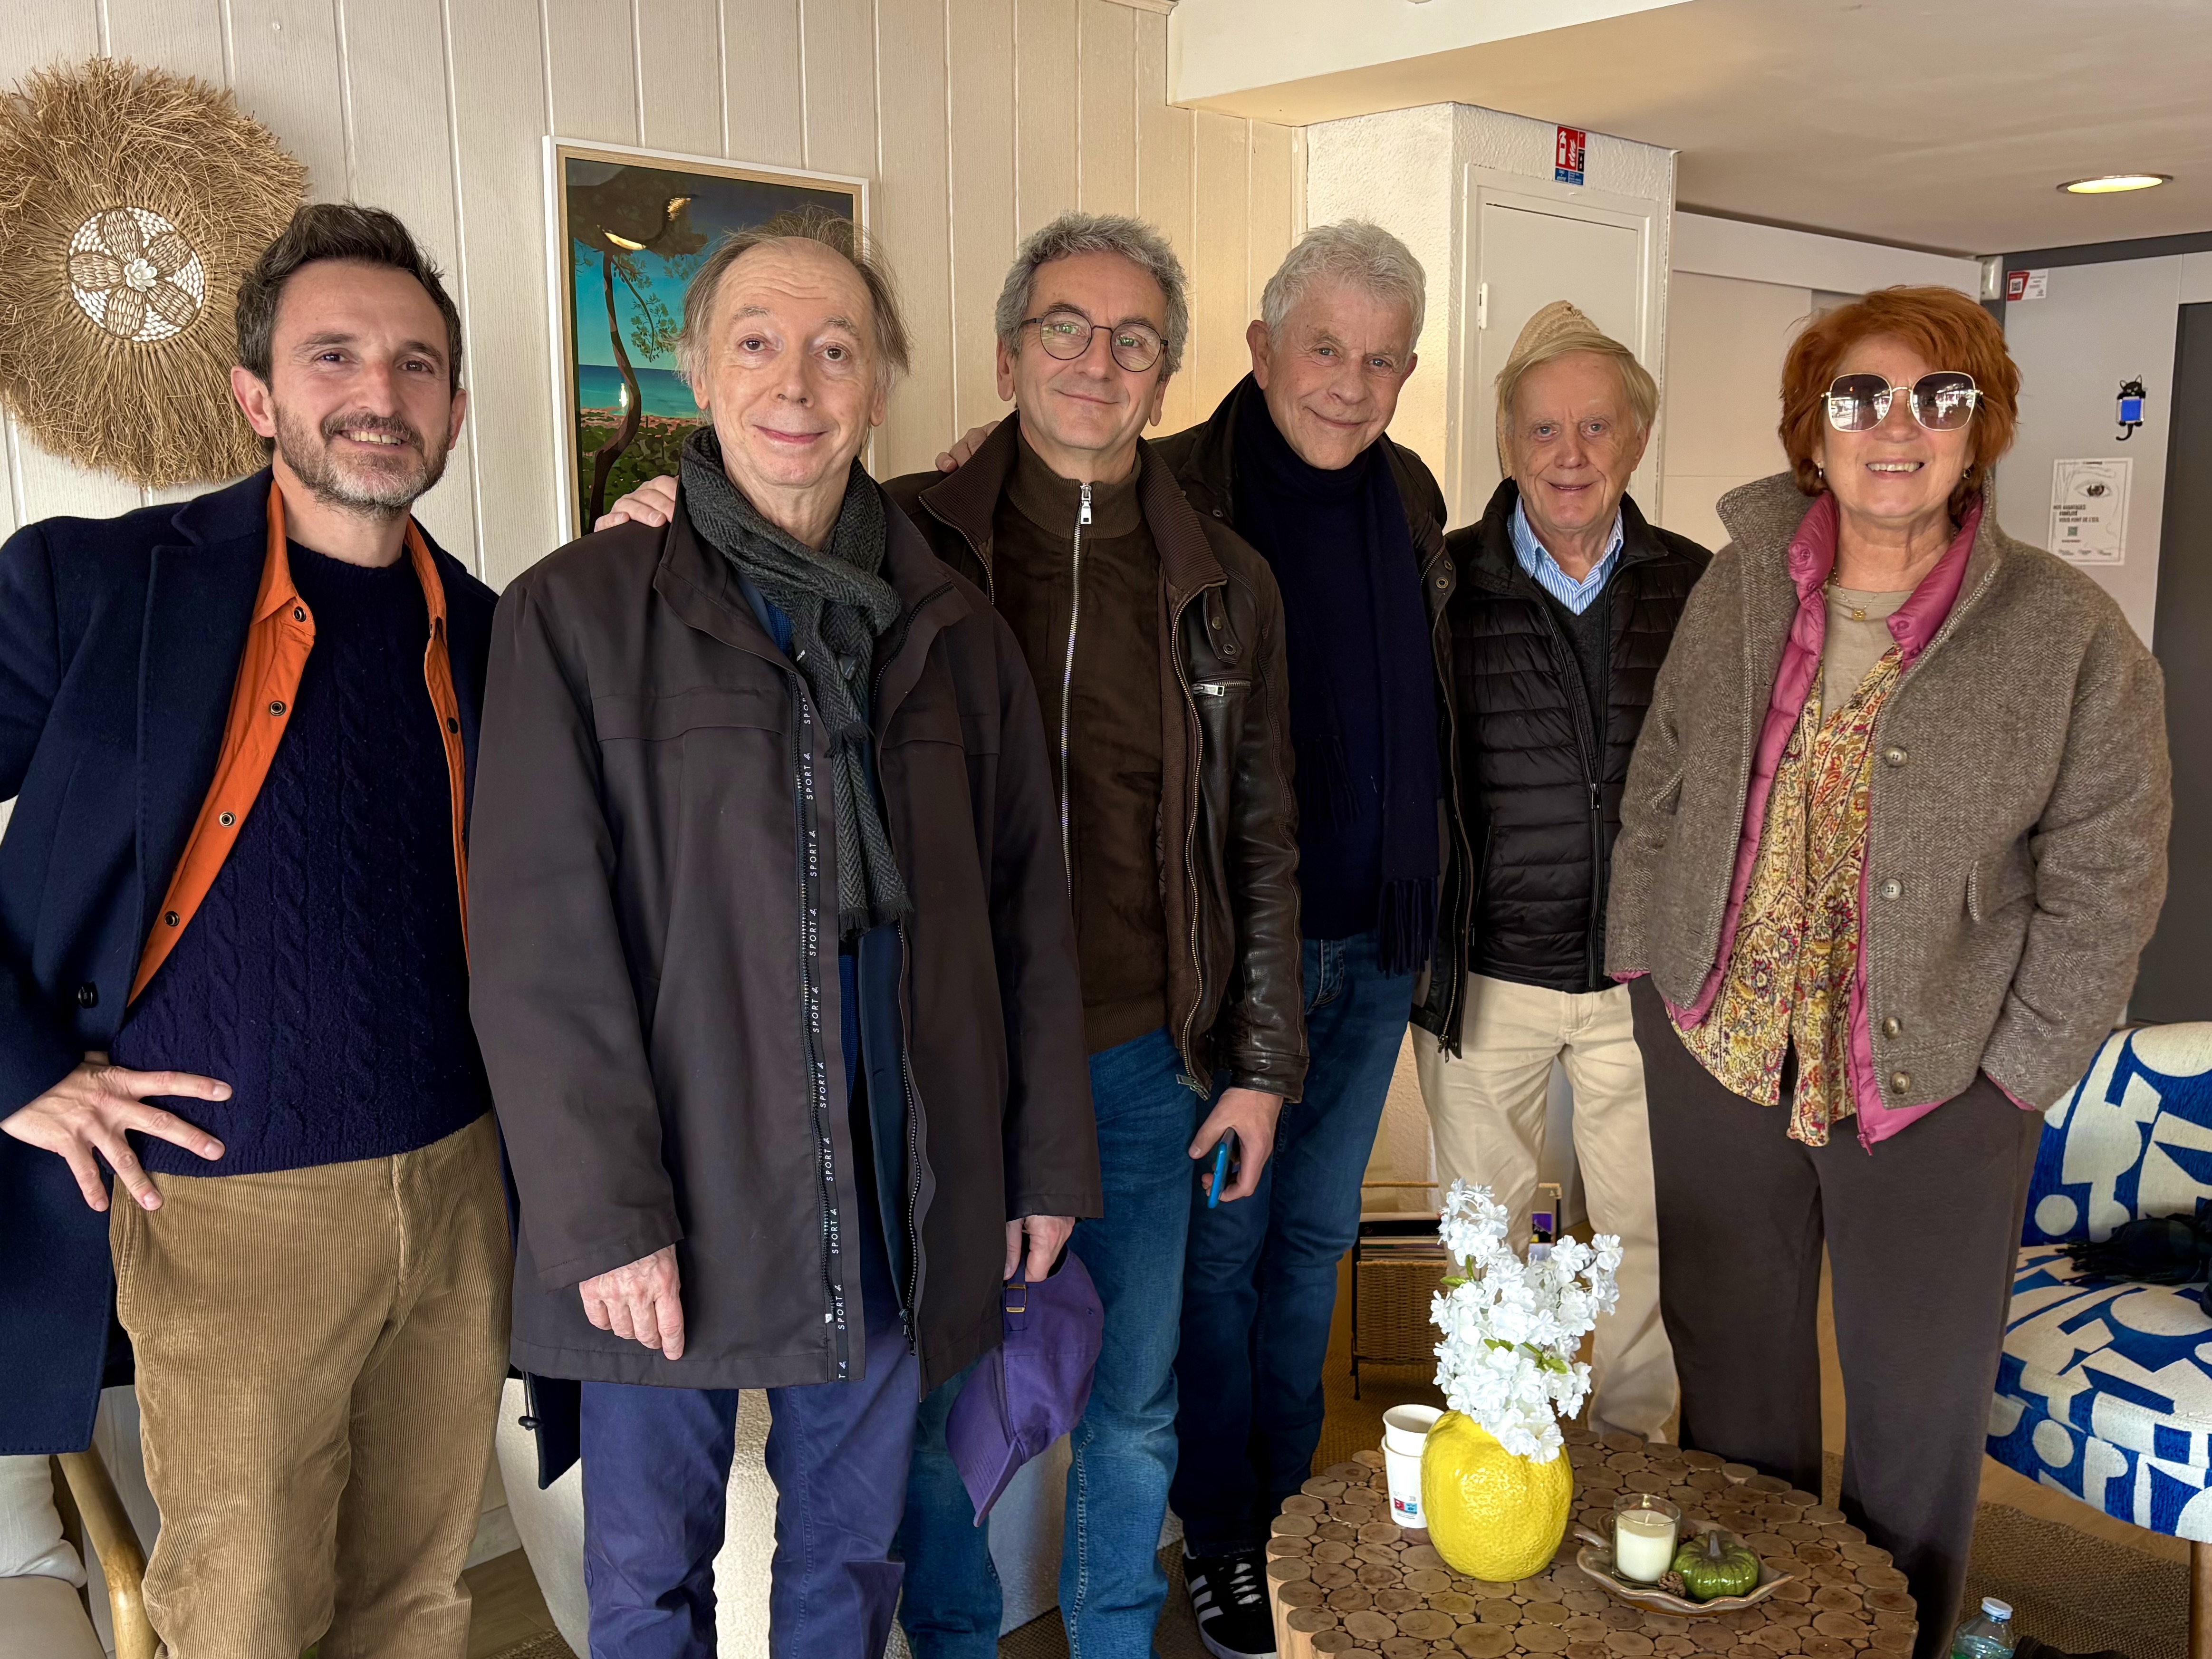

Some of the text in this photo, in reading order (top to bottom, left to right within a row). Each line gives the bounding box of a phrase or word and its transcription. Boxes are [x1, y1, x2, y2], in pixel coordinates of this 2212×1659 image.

[804, 765, 813, 800] SPORT
[809, 842, 817, 877] SPORT
[809, 921, 817, 956] SPORT
[811, 998, 819, 1033] SPORT
[818, 1073, 827, 1108] SPORT
[824, 1148, 833, 1181] SPORT
[830, 1220, 839, 1254] SPORT
[835, 1295, 845, 1330] SPORT
